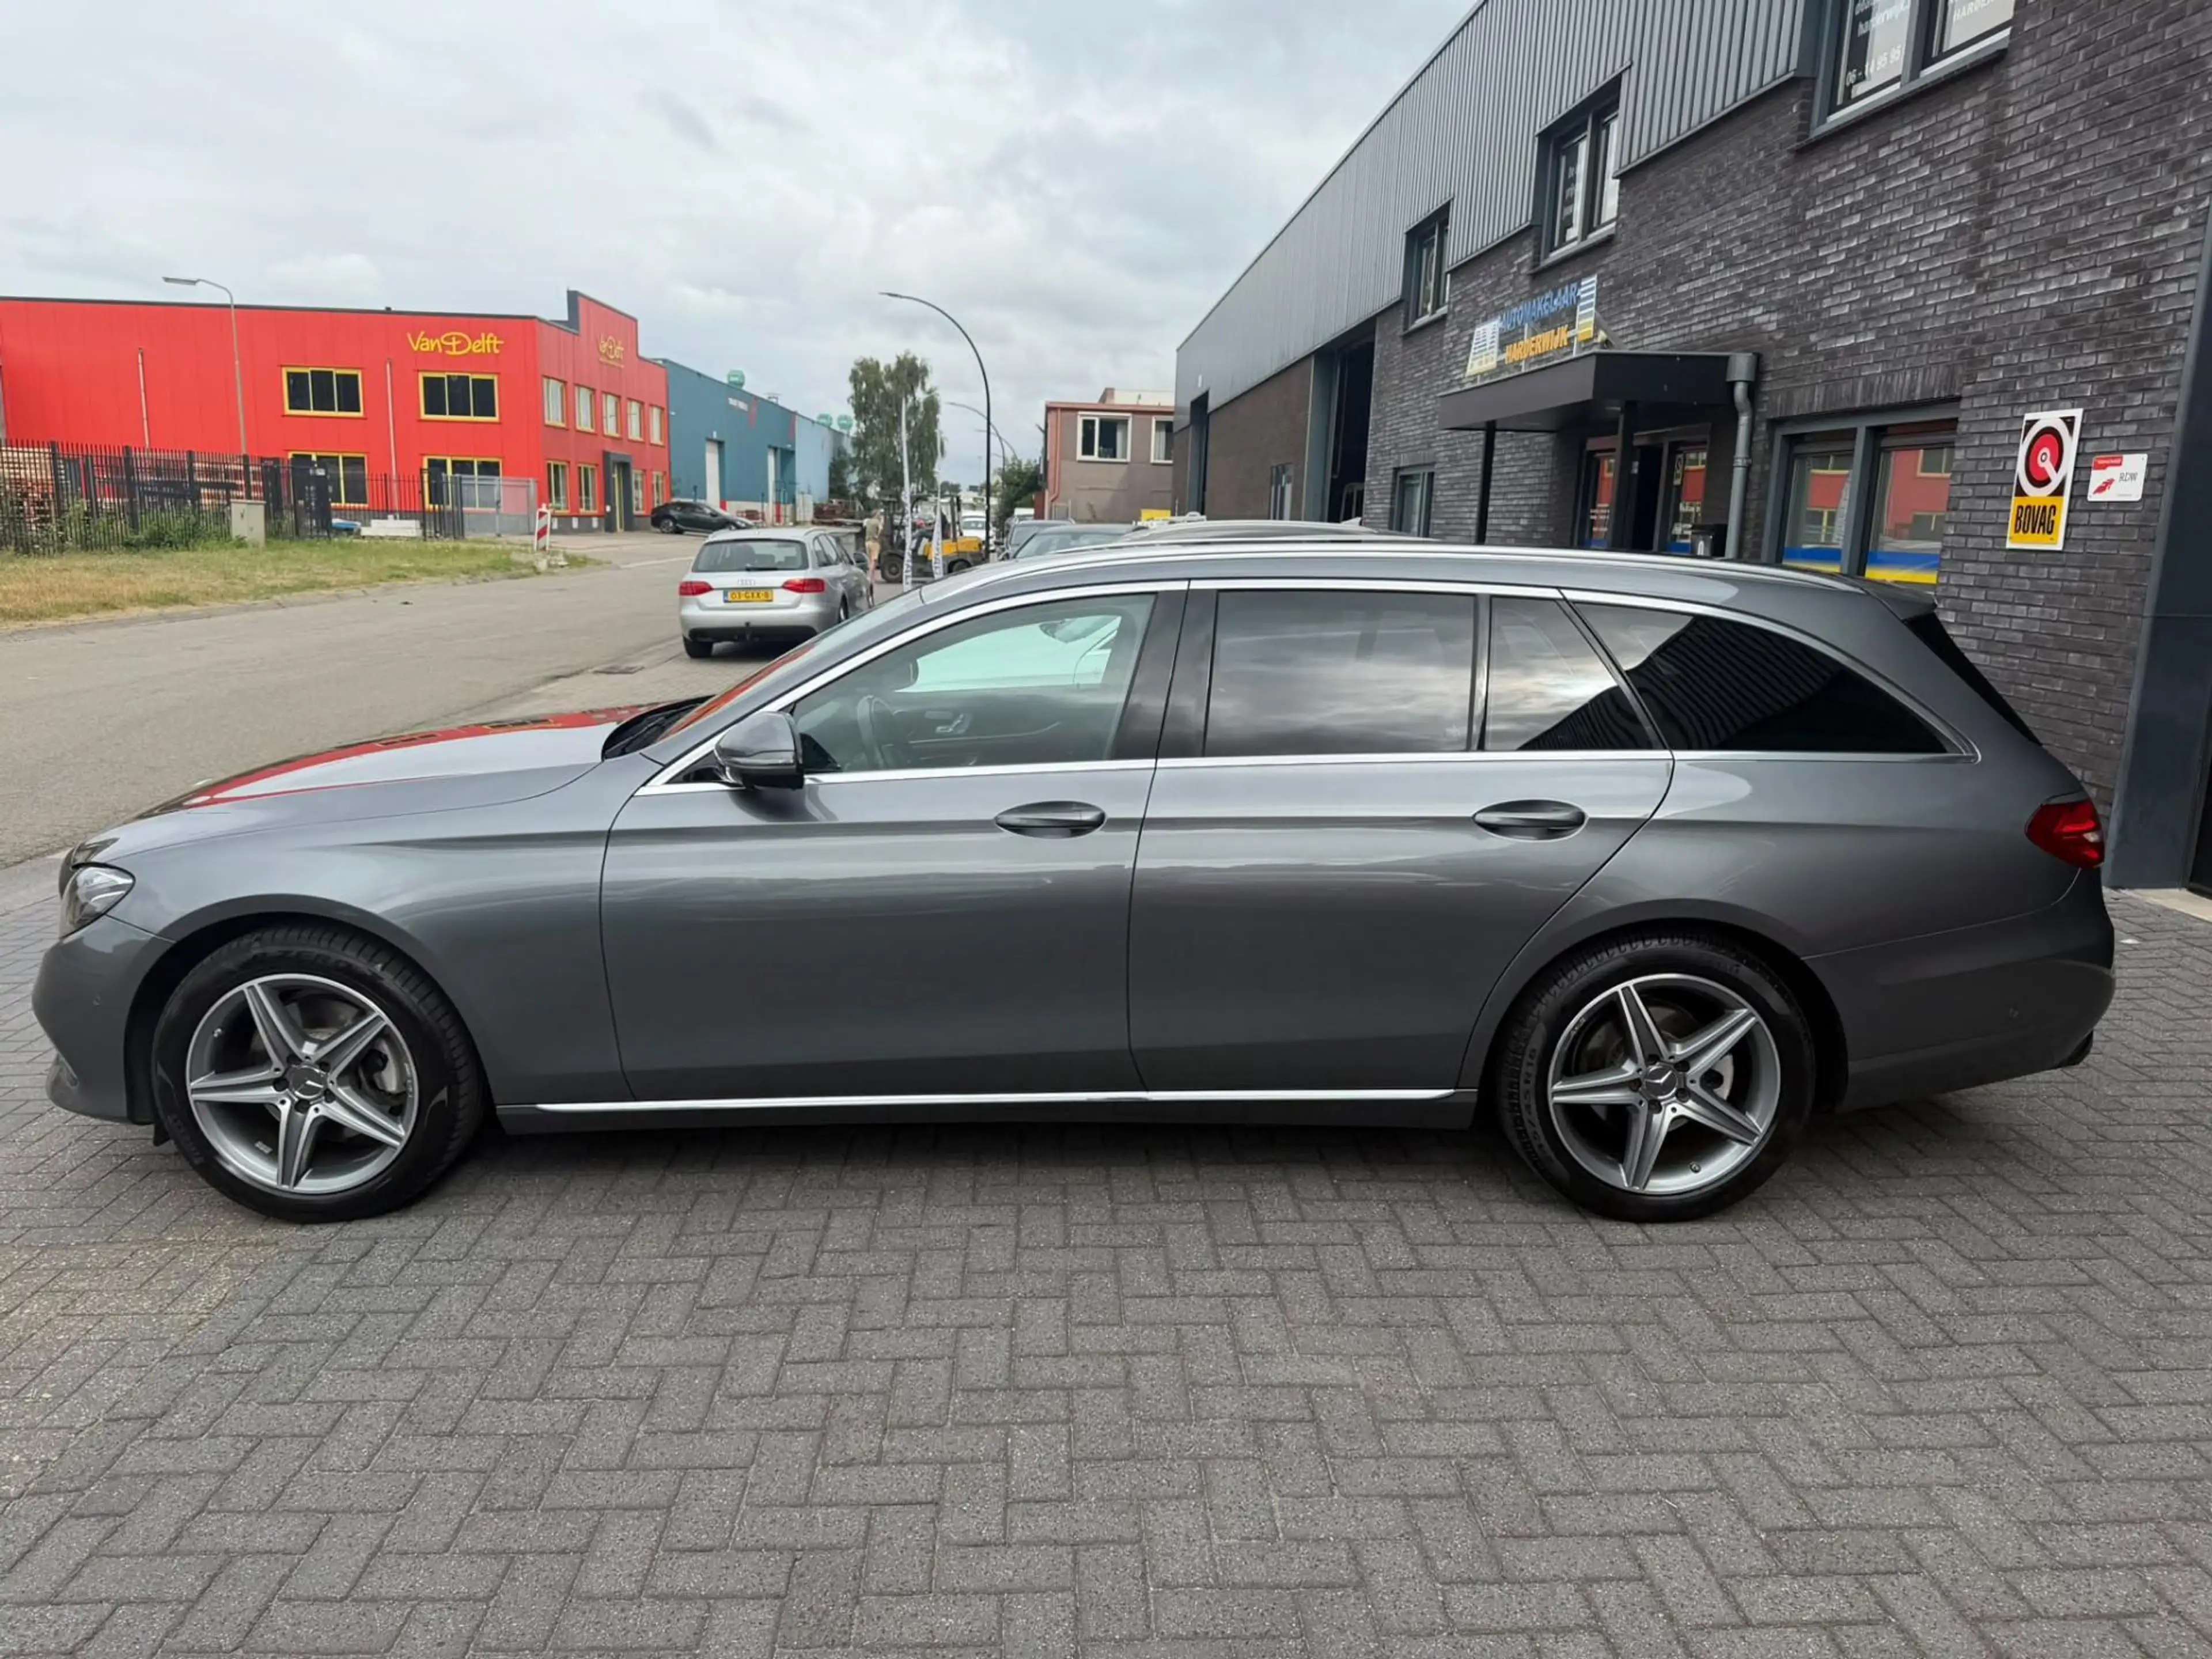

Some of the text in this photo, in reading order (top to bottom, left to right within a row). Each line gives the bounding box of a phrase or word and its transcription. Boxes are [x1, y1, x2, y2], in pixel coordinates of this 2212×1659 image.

[407, 331, 505, 355] Van Delft
[1505, 325, 1569, 364] HARDERWIJK
[2014, 505, 2056, 535] BOVAG
